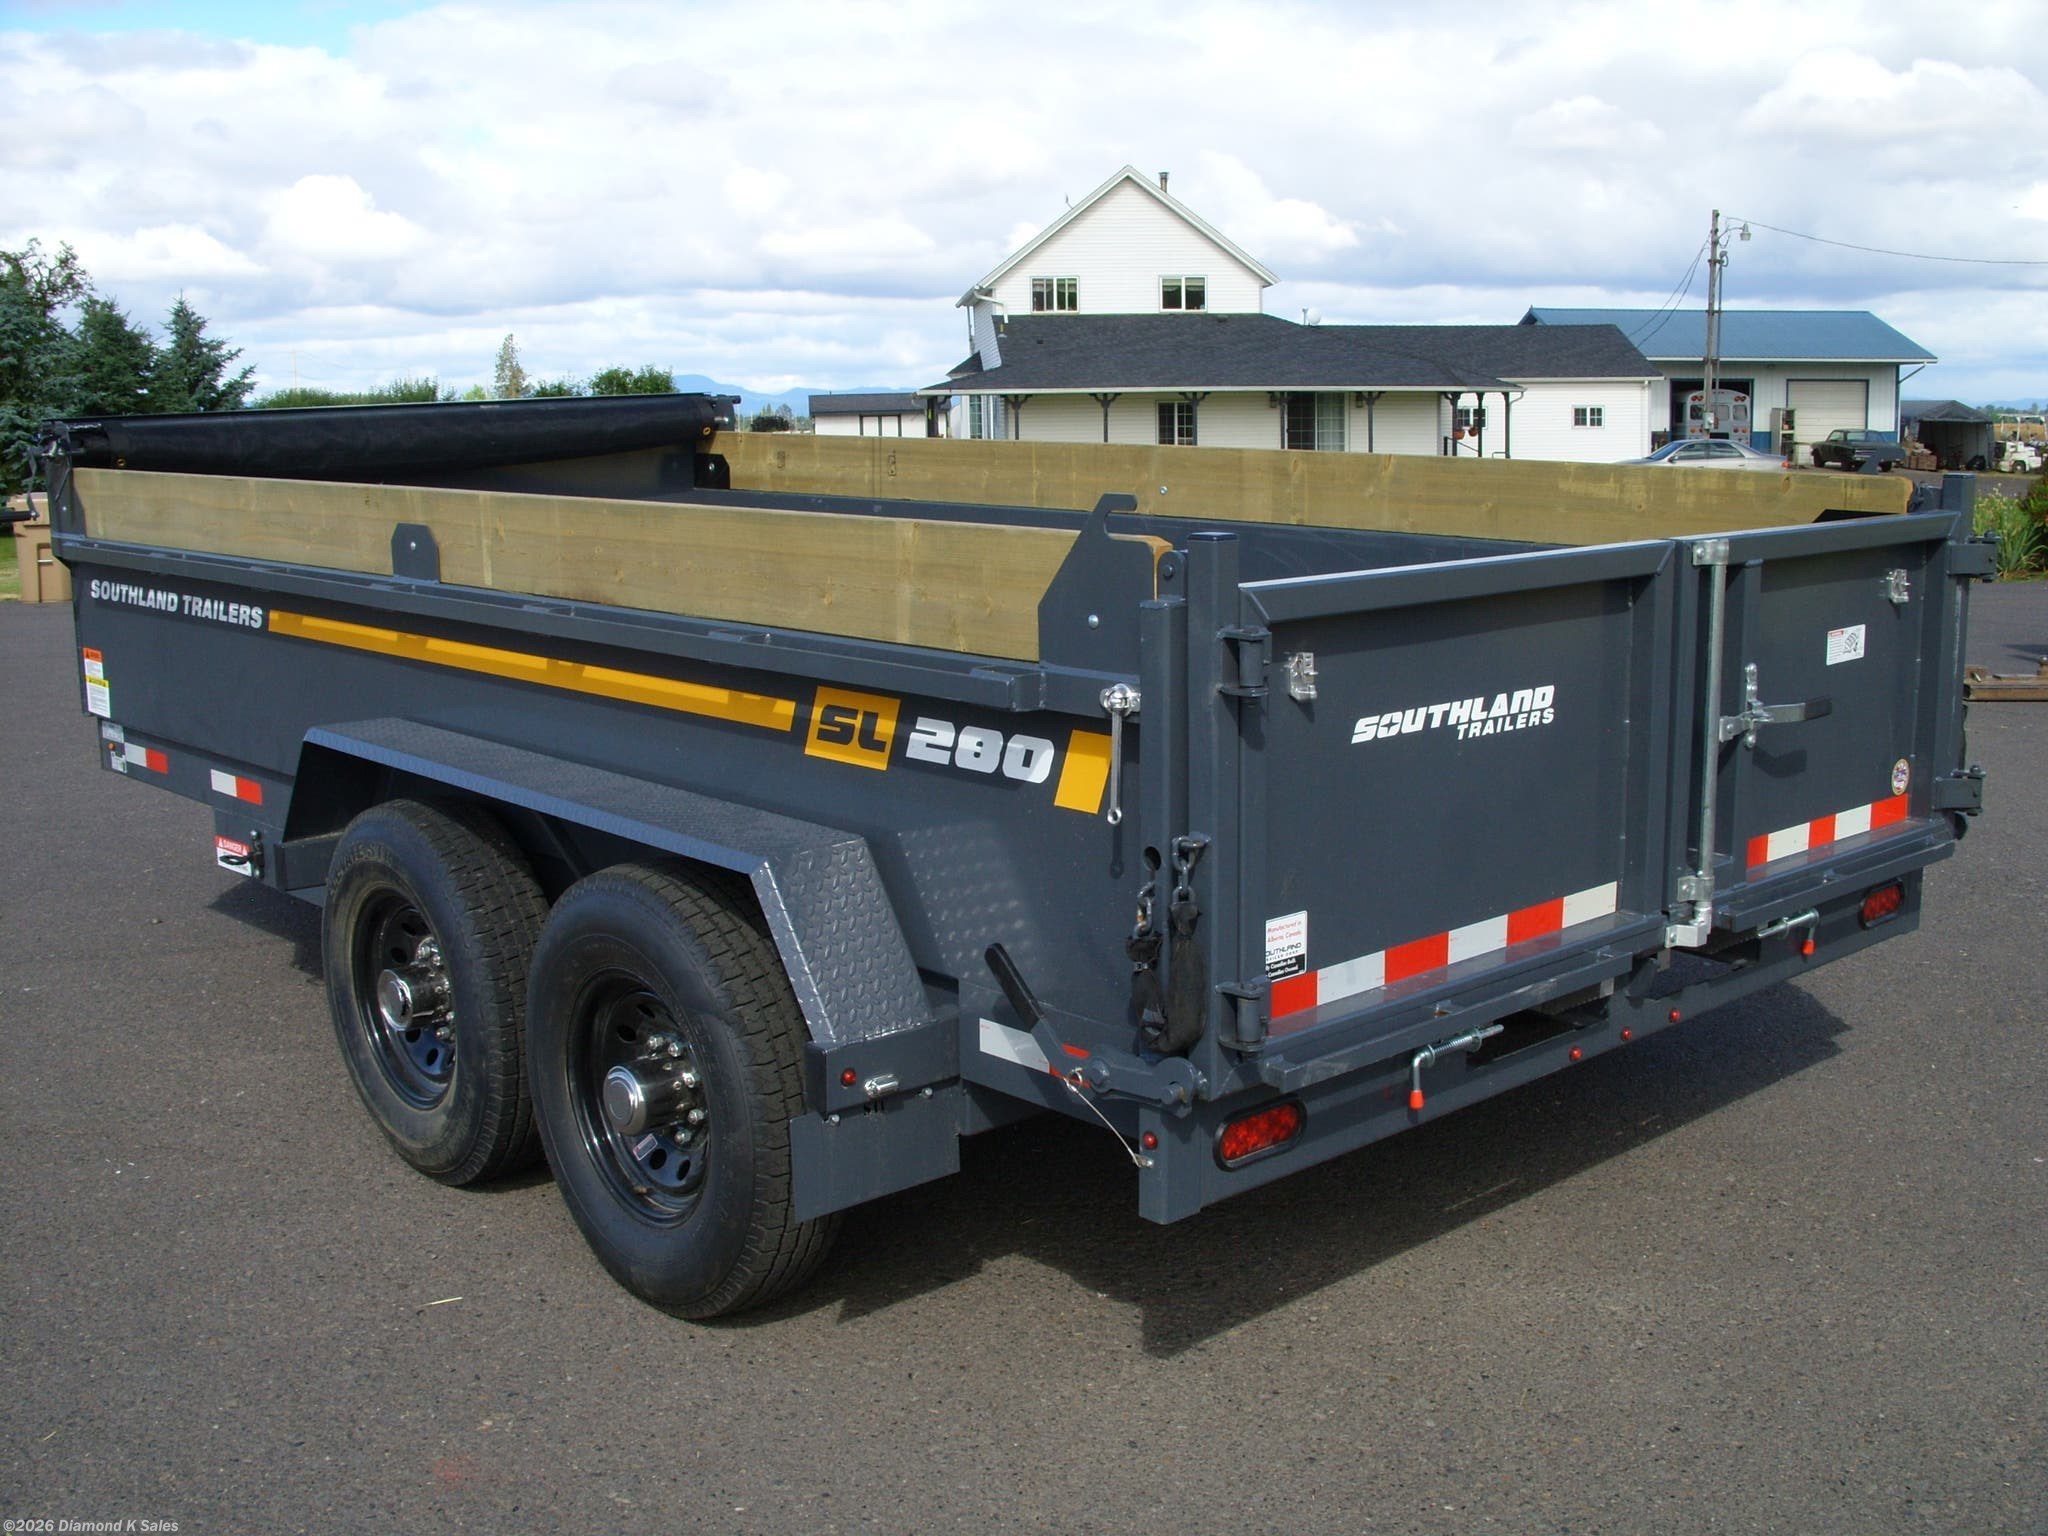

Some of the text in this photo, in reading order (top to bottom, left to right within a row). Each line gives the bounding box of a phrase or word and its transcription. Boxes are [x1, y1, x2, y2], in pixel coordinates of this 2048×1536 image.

[91, 579, 263, 629] SOUTHLAND TRAILERS
[1351, 685, 1555, 744] SOUTHLAND
[1457, 708, 1554, 740] TRAILERS
[816, 704, 1055, 784] SL 280
[1265, 942, 1302, 956] OUTHLAND
